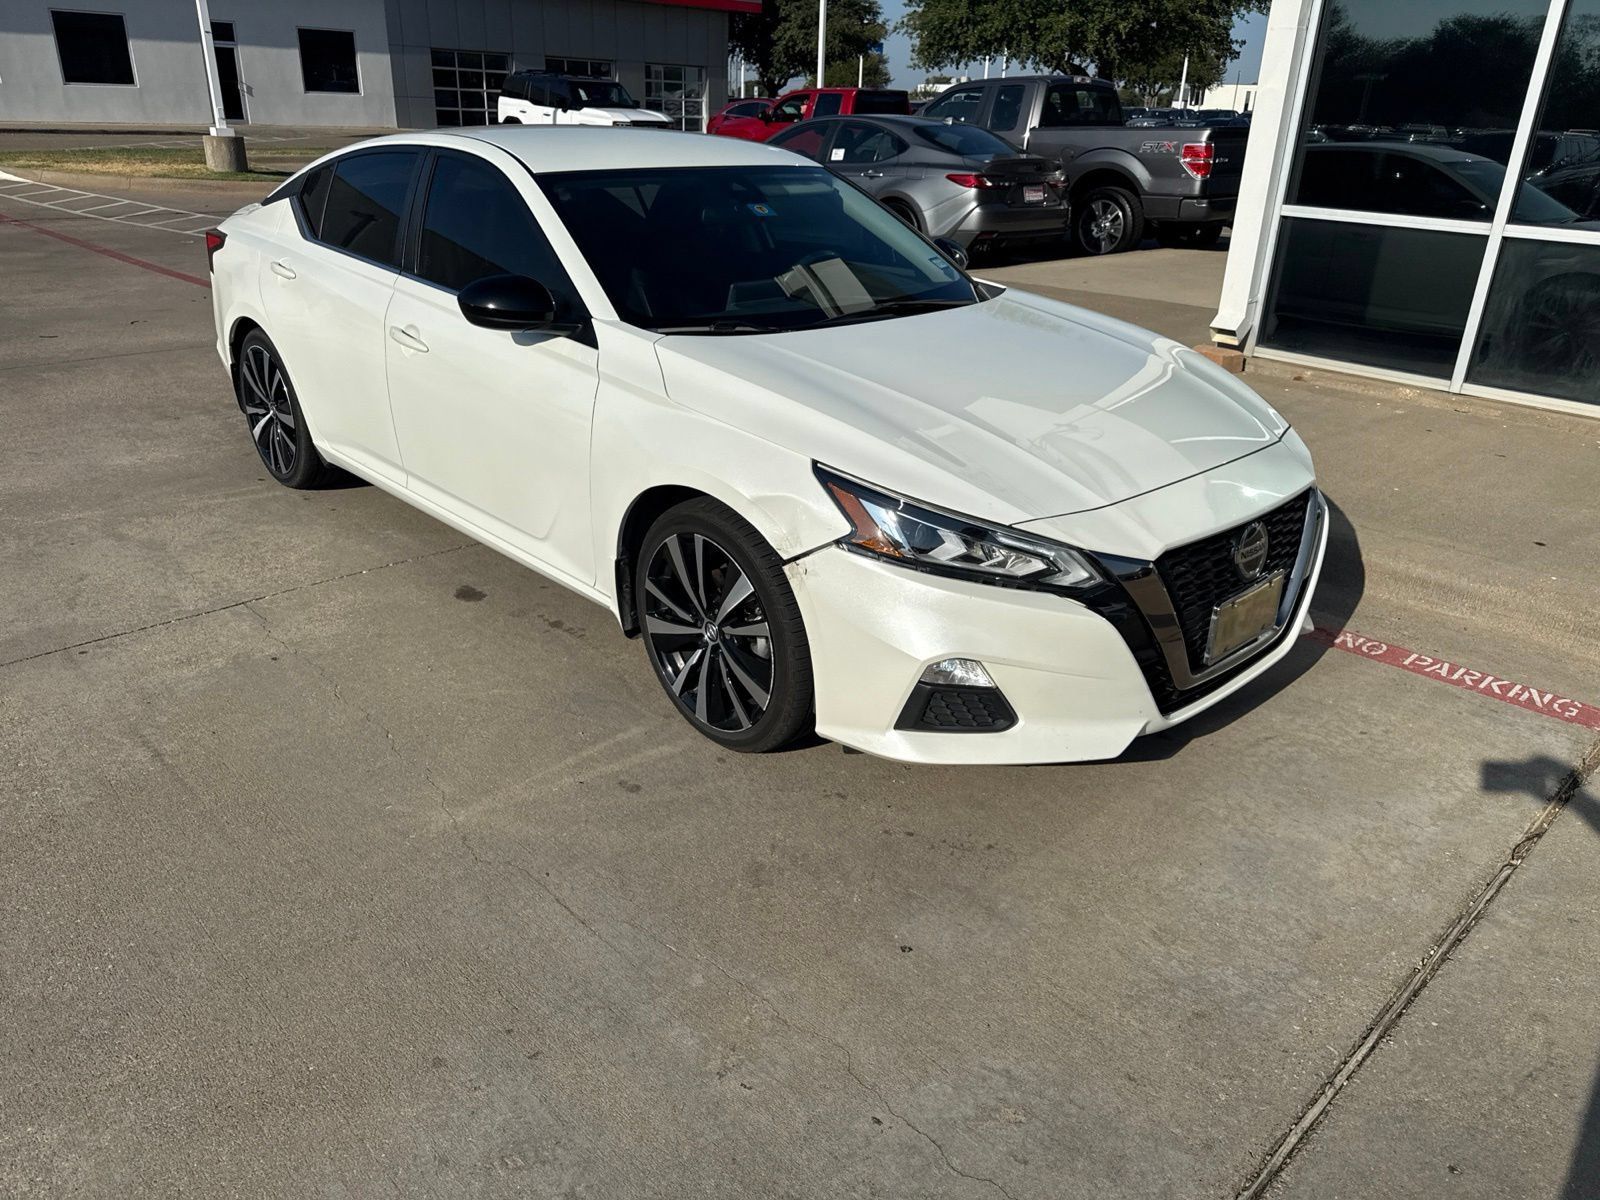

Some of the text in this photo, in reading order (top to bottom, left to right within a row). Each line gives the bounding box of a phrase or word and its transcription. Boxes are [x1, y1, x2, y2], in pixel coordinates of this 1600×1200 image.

[1139, 141, 1179, 153] STX
[1334, 632, 1582, 718] NO PARKING
